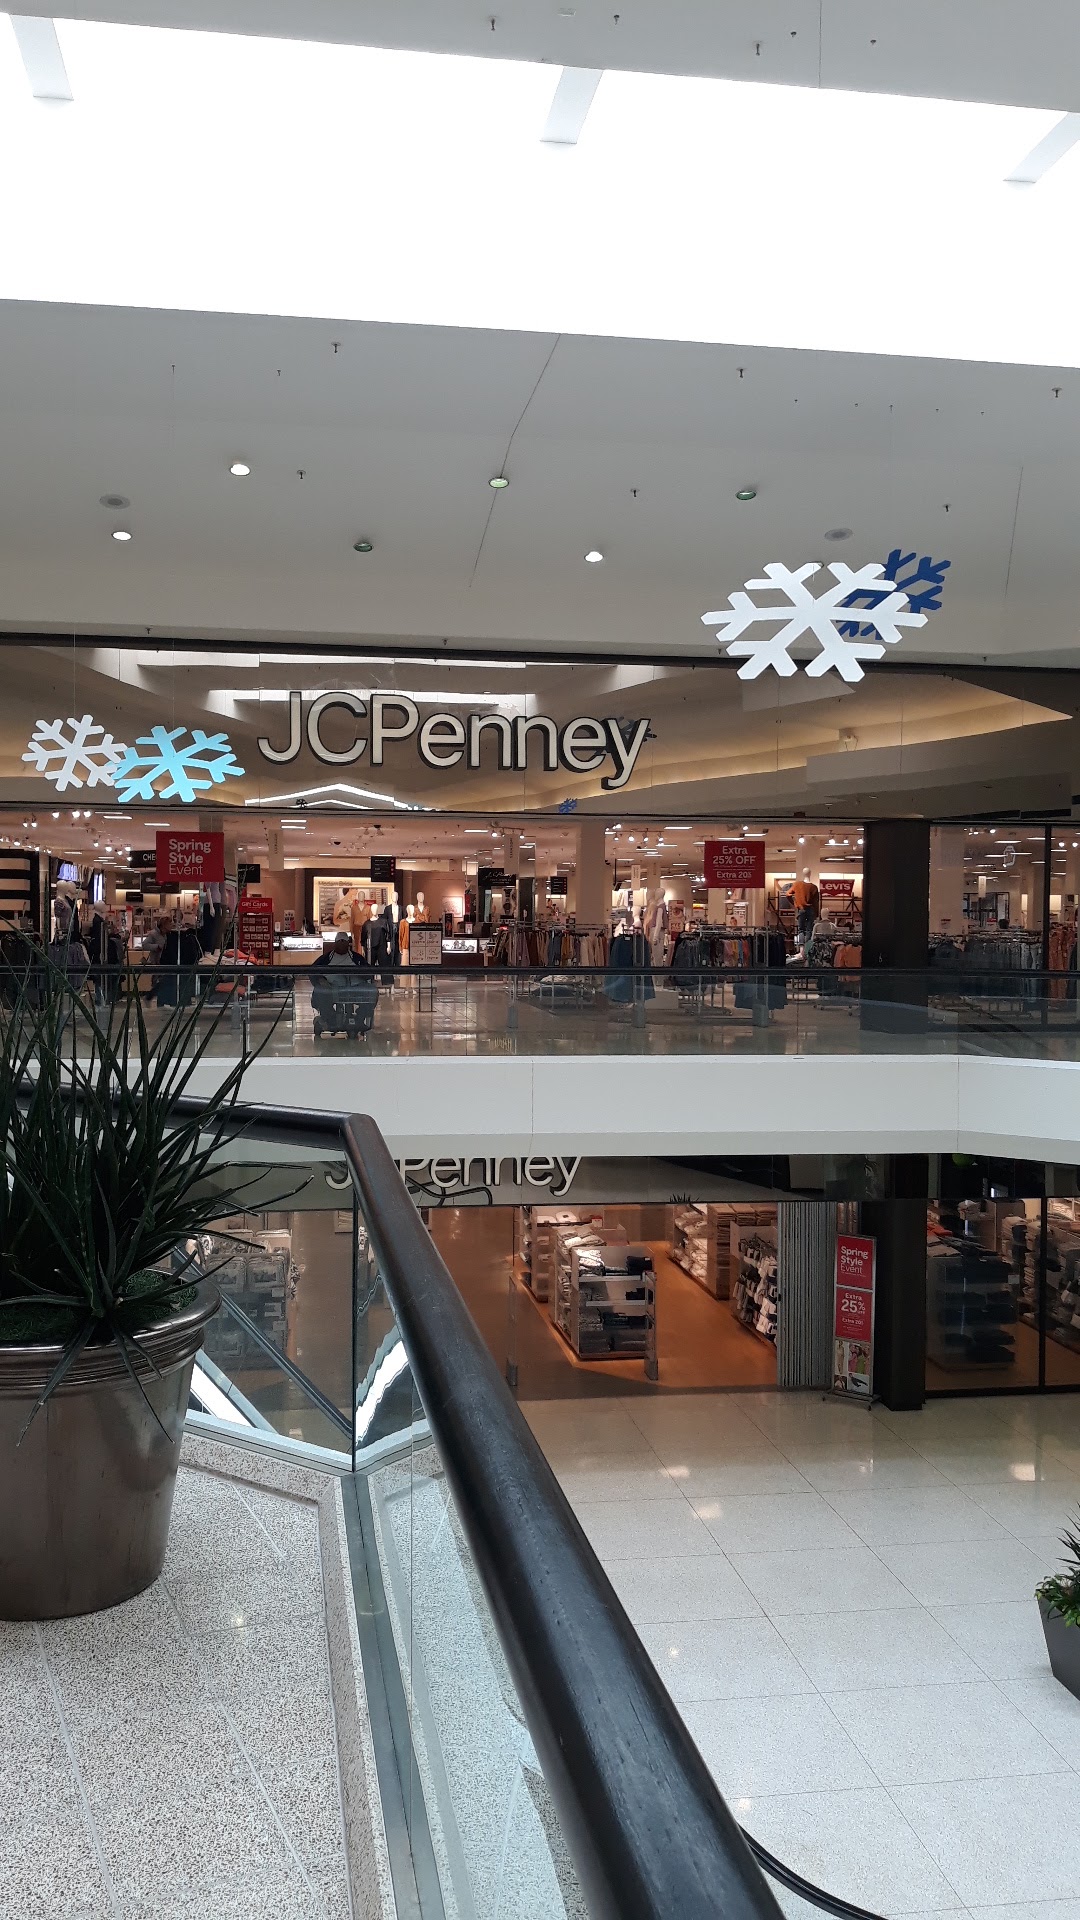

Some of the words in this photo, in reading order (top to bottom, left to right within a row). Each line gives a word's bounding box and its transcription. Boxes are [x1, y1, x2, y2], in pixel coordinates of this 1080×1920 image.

[257, 691, 651, 790] JCPenney
[168, 839, 211, 853] Spring
[722, 845, 748, 855] Extra
[168, 852, 204, 866] Style
[712, 855, 733, 865] 25%
[735, 855, 757, 865] OFF
[168, 863, 203, 876] Event
[716, 871, 737, 879] Extra
[840, 1246, 869, 1260] Spring
[840, 1255, 863, 1267] Style
[840, 1263, 863, 1275] Event
[845, 1292, 863, 1301] Extra
[841, 1299, 866, 1313] 25%
